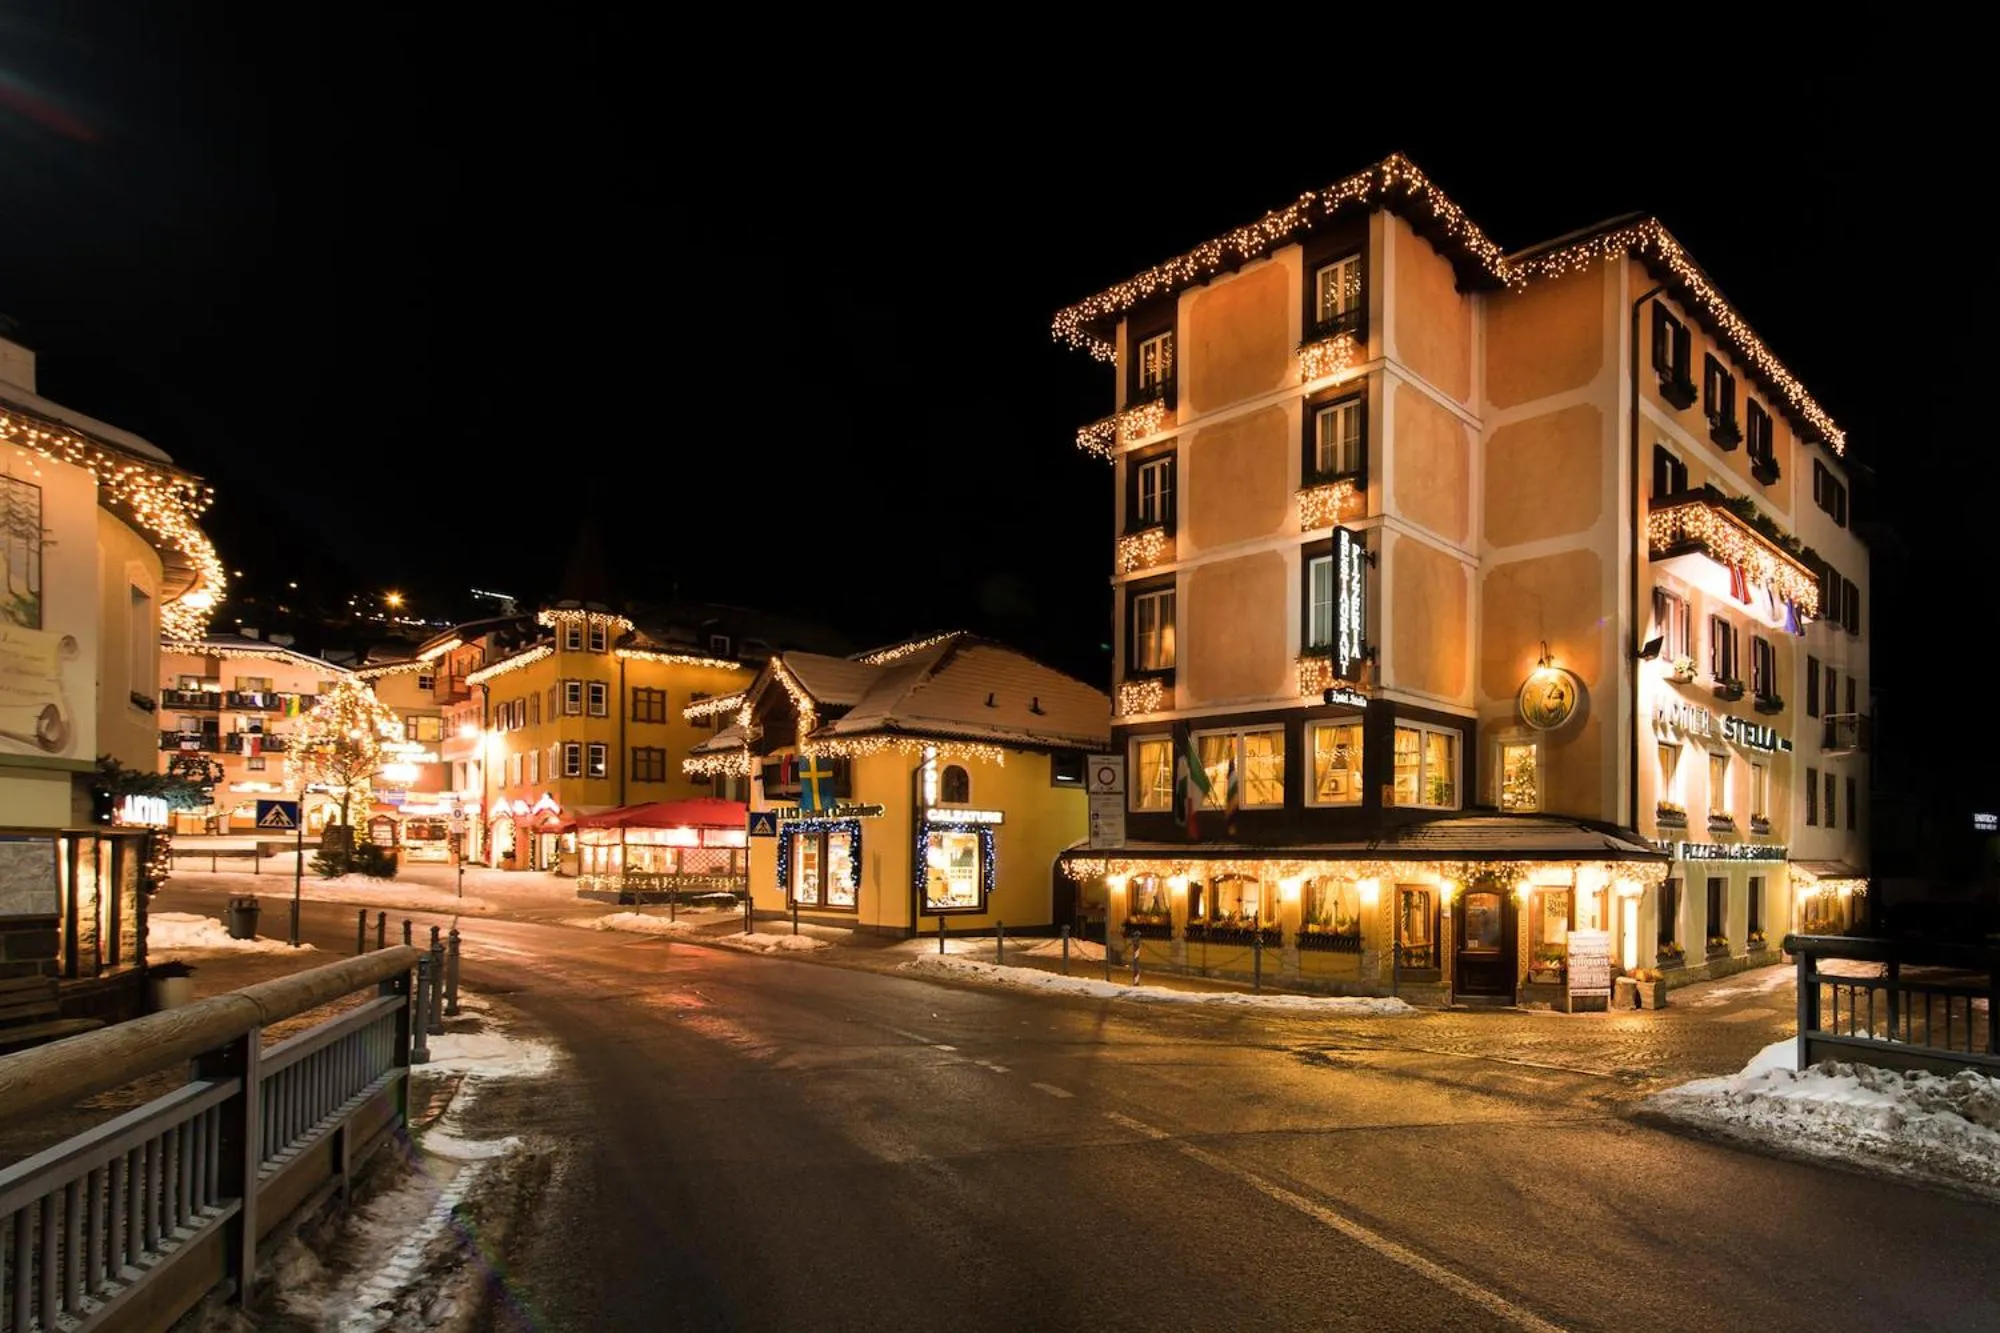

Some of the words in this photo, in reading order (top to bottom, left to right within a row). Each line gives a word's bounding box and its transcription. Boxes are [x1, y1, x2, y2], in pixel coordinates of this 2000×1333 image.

[1339, 529, 1350, 676] RESTAURANT
[1351, 543, 1361, 660] PIZZERIA
[1720, 713, 1777, 754] STELLA
[926, 808, 1003, 823] CALZATURE
